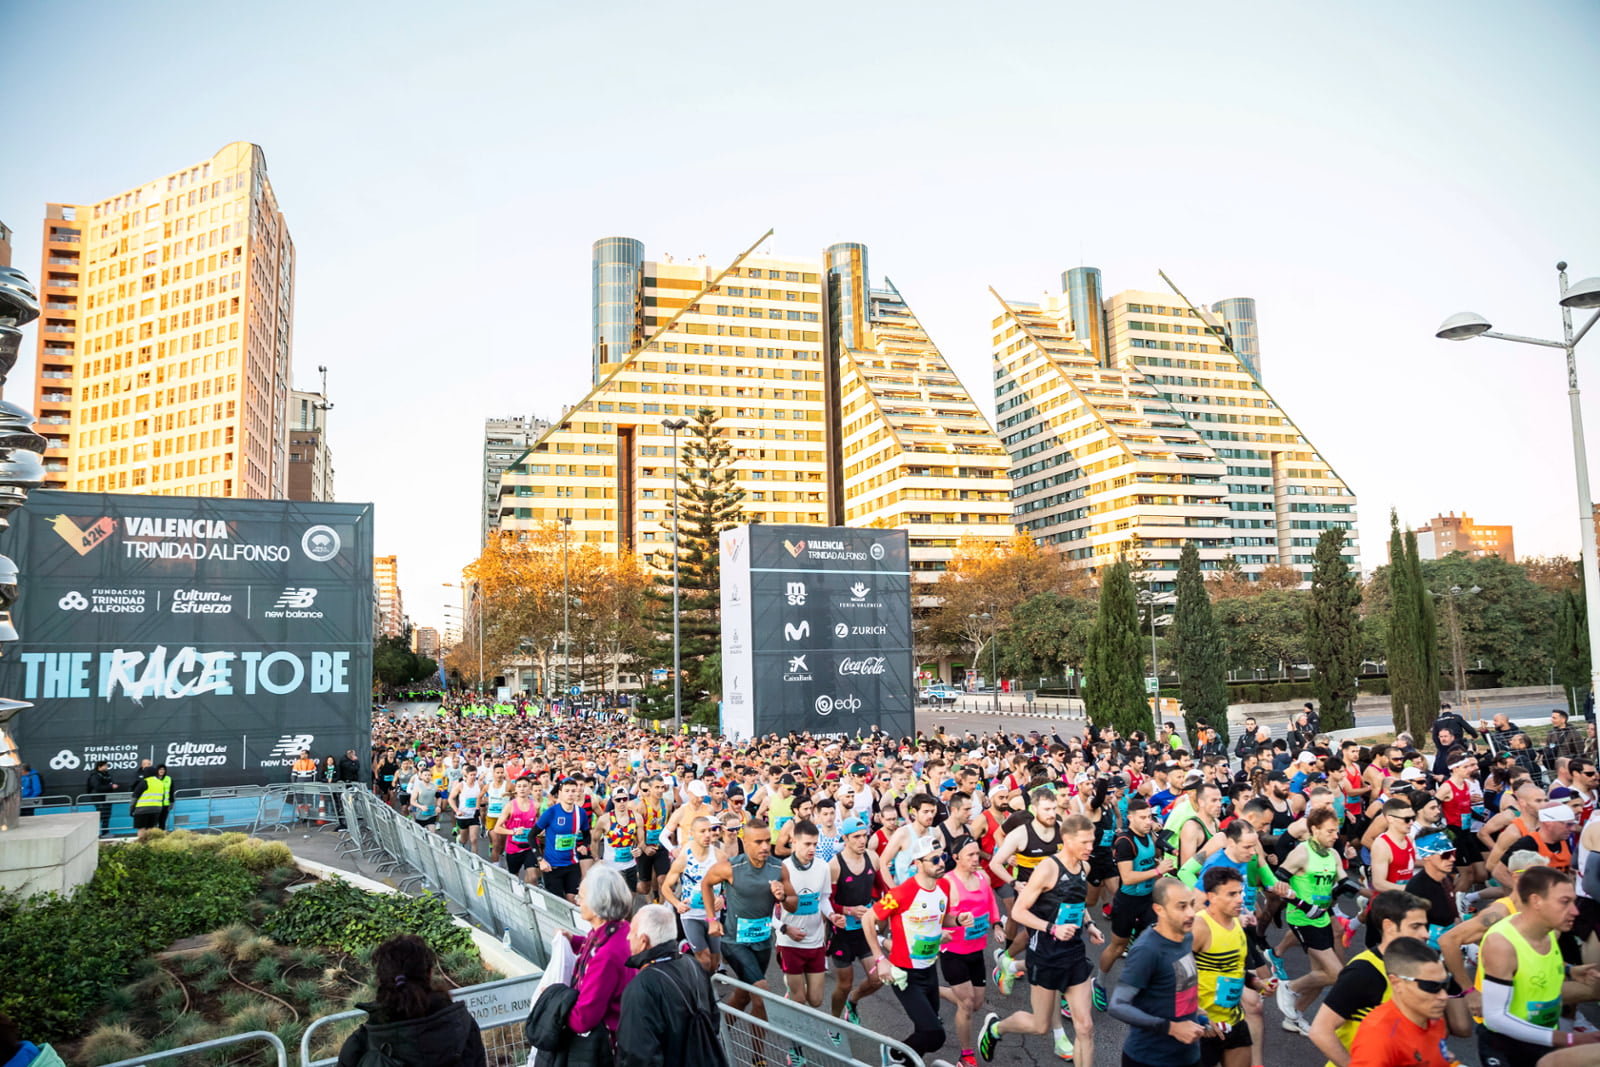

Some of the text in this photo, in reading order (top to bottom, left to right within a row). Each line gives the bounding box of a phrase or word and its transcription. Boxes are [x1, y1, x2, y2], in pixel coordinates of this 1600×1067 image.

[124, 516, 229, 539] VALENCIA
[81, 525, 107, 547] 42K
[808, 540, 844, 550] VALENCIA
[122, 540, 207, 560] TRINIDAD
[207, 543, 291, 562] ALFONSO
[808, 550, 837, 560] TRINIDAD
[837, 551, 868, 561] ALFONSO
[92, 588, 146, 596] FUNDACIÓN
[173, 588, 233, 602] Cultura del
[91, 595, 145, 605] TRINIDAD
[91, 604, 145, 613] ALFONSO
[171, 601, 232, 614] Esfuerzo
[265, 610, 324, 619] new balance
[851, 626, 887, 635] ZURICH
[20, 651, 92, 698] THE
[241, 651, 305, 695] TO
[310, 651, 350, 694] BE
[834, 693, 862, 714] edp
[84, 744, 139, 752] FUNDACIÓN
[167, 742, 228, 754] Cultura del
[83, 752, 138, 762] TRINIDAD
[165, 754, 227, 767] Esfuerzo
[260, 759, 281, 767] new
